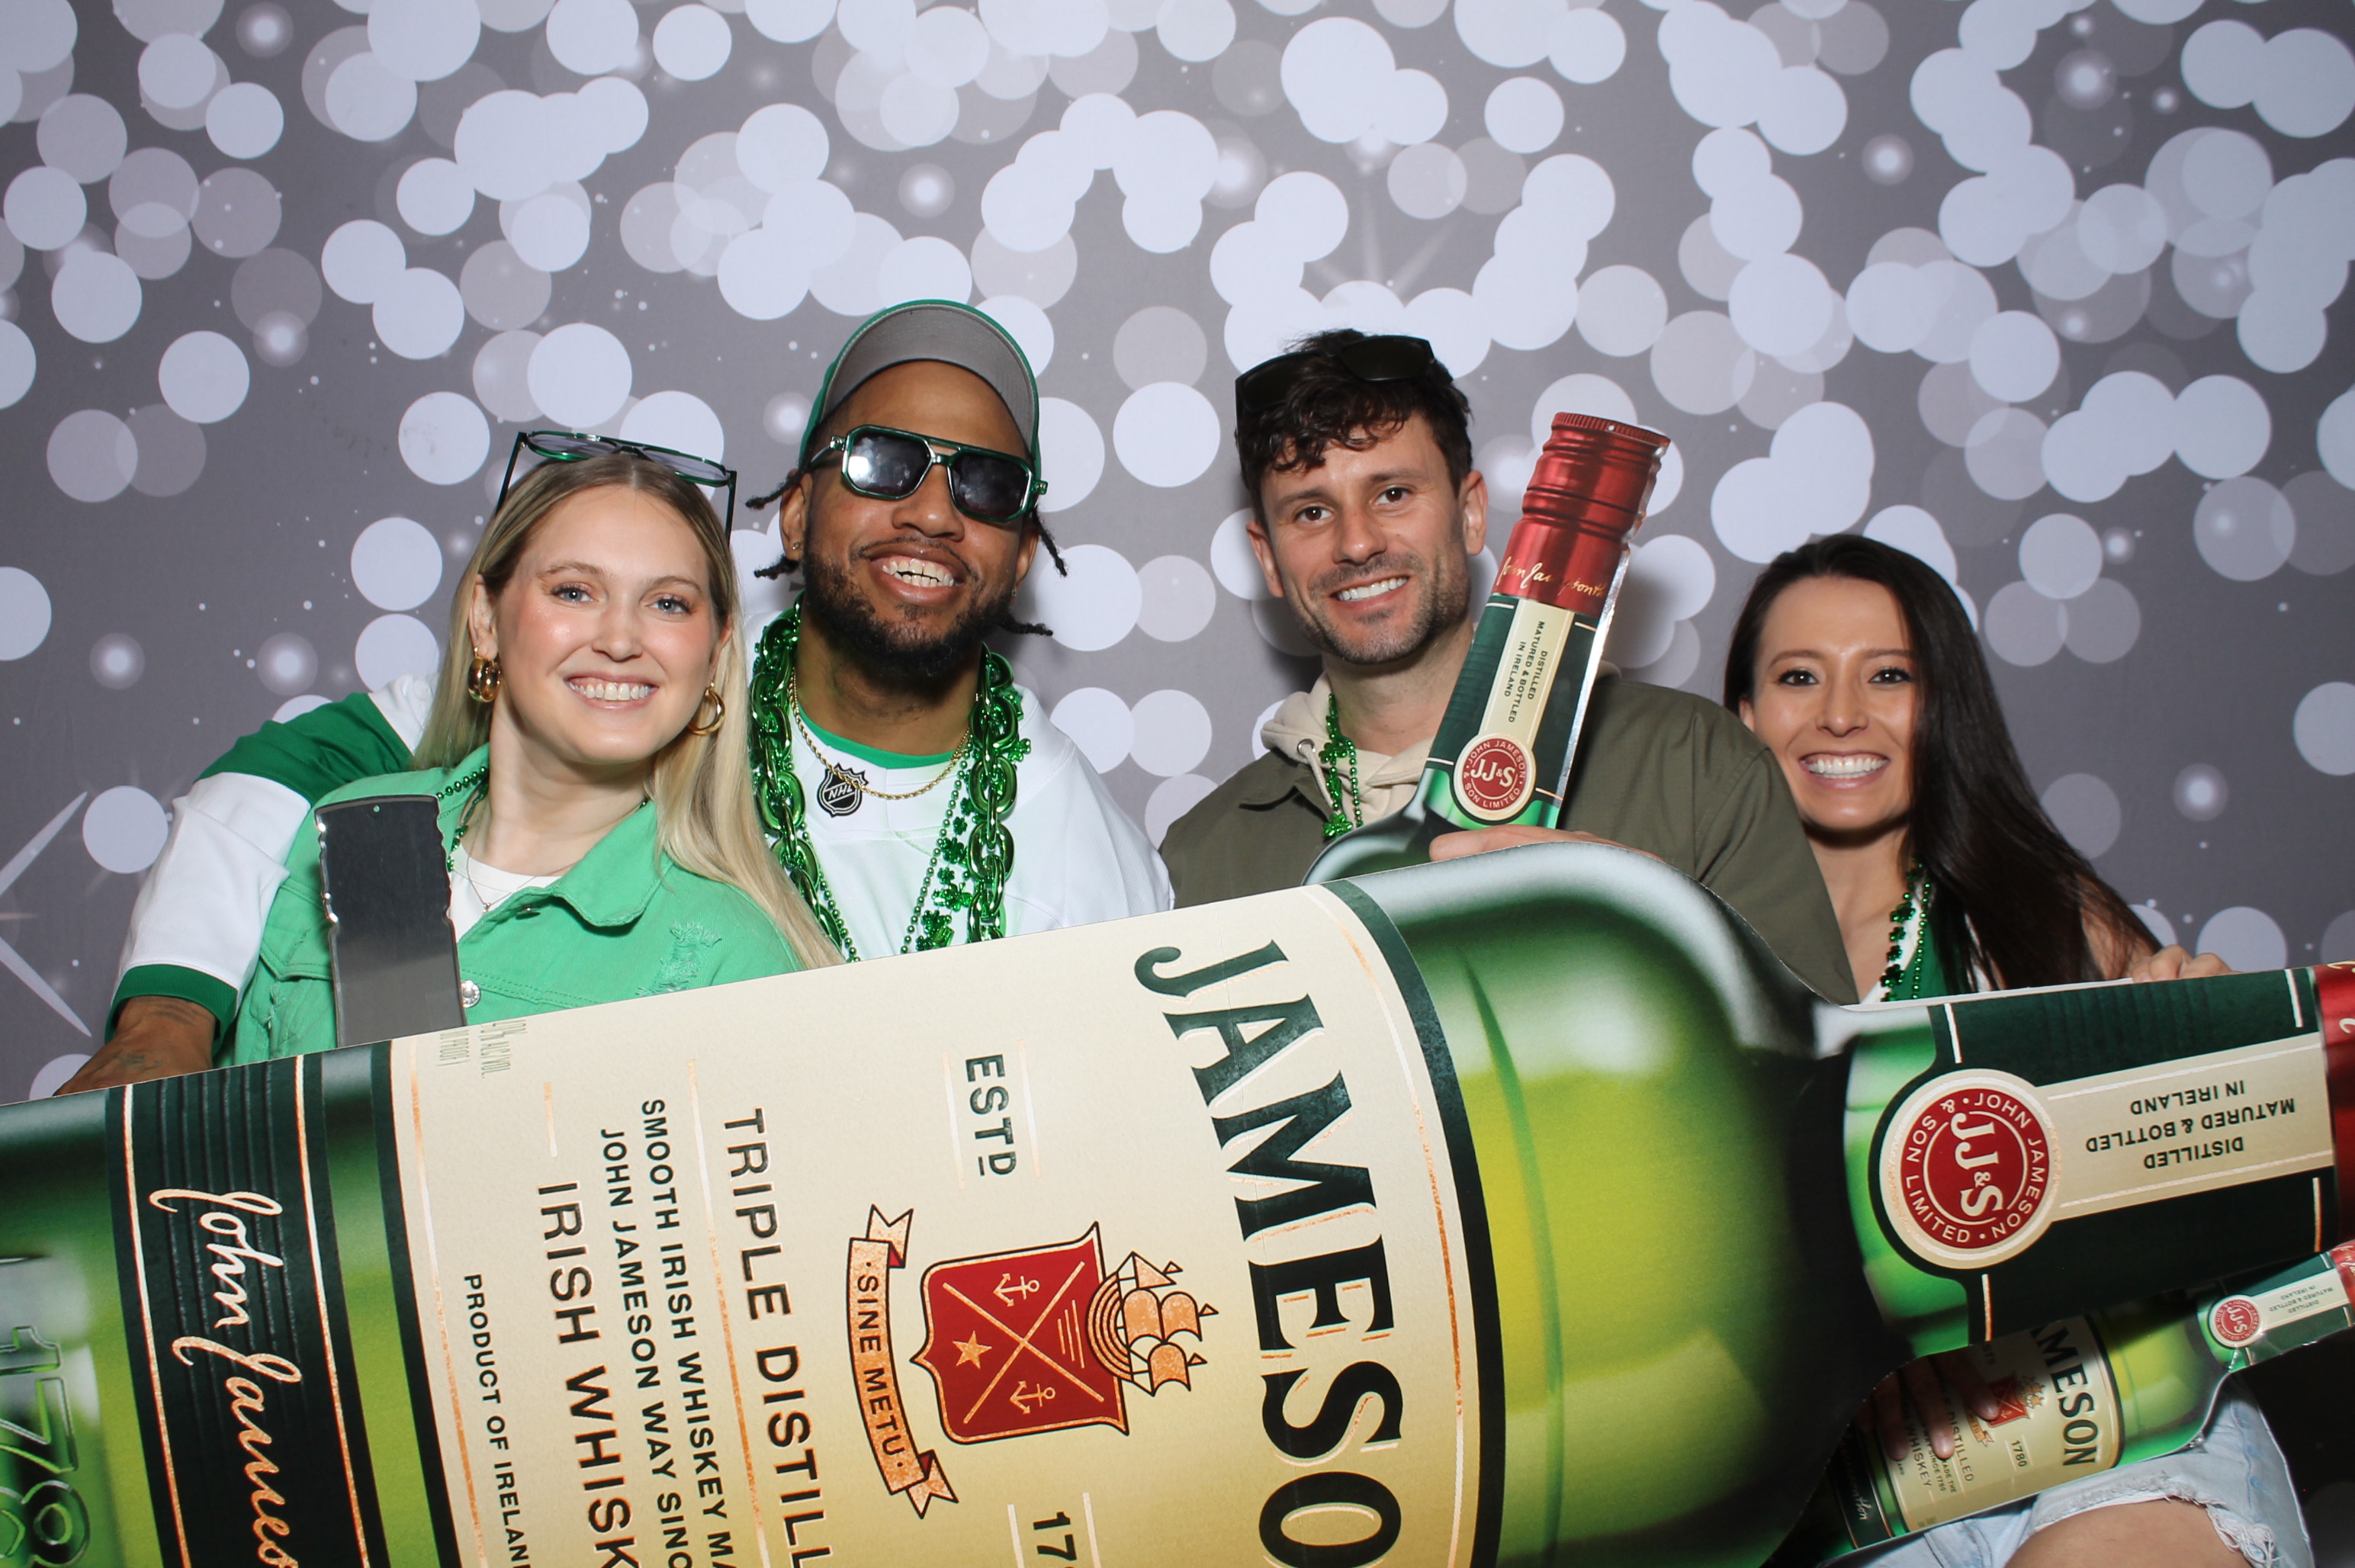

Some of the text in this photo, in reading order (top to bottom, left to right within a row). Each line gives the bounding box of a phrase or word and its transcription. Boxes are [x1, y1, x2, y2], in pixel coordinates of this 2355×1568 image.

[1504, 641, 1526, 697] IN IRELAND
[1525, 621, 1545, 667] MATURED
[1508, 678, 1528, 723] BOTTLED
[1528, 651, 1547, 700] DISTILLED
[1467, 740, 1525, 778] JOHN JAMESON
[1470, 758, 1516, 787] JJ&S
[828, 784, 853, 800] NHL
[1464, 782, 1481, 803] SON
[1483, 787, 1520, 808] LIMITED
[2085, 1098, 2296, 1152] MATURED & BOTTLED
[2130, 1080, 2245, 1115] IN IRELAND
[600, 1129, 634, 1207] JOHN
[641, 1099, 680, 1229] SMOOTH
[1906, 1098, 1971, 1242] & SON LIMITED
[1950, 1112, 2003, 1216] JJ&S
[1974, 1092, 2046, 1239] JOHN JAMESON
[2143, 1136, 2244, 1169] DISTILLED
[723, 1107, 792, 1320] TRIPLE
[149, 1187, 284, 1329] John
[612, 1220, 661, 1389] JAMESON
[660, 1243, 697, 1338] IRISH
[2226, 1306, 2247, 1333] JJ&S
[538, 1181, 639, 1568] IRISH WHISK
[857, 1274, 905, 1456] SINE METU
[464, 1274, 531, 1568] PRODUCT OF IRELAN
[641, 1401, 677, 1480] WAY
[677, 1351, 728, 1519] WHISKEY
[1906, 1424, 1933, 1487] WHISKEY
[1942, 1460, 1957, 1492] ADE THE
[2011, 1439, 2028, 1467] 1780
[1033, 1512, 1077, 1568] 17
